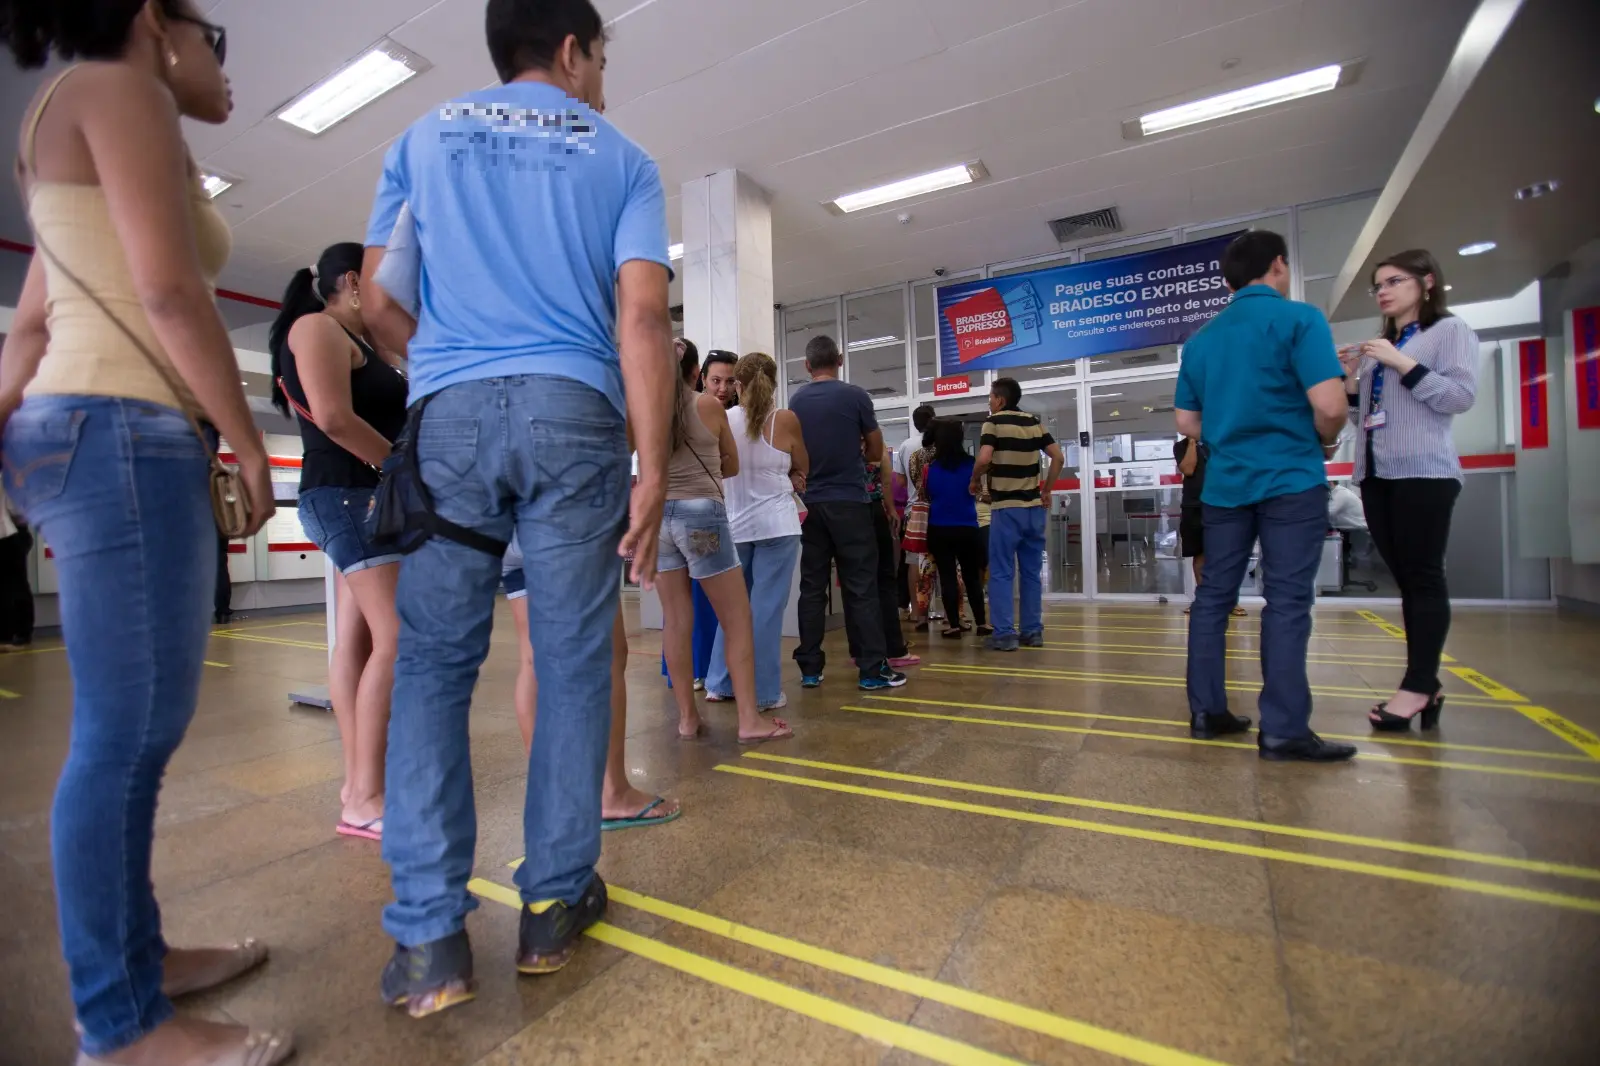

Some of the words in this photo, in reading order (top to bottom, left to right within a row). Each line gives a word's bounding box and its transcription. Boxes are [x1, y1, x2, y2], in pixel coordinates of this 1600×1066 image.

[1055, 280, 1102, 297] Pague
[1106, 273, 1143, 288] suas
[1148, 262, 1205, 281] contas
[1209, 259, 1221, 271] n
[1049, 289, 1137, 316] BRADESCO
[955, 309, 1007, 326] BRADESCO
[1052, 319, 1076, 330] Tem
[1079, 312, 1122, 325] sempre
[1125, 309, 1144, 319] um
[1147, 303, 1181, 318] perto
[1184, 299, 1200, 310] de
[956, 318, 1007, 335] EXPRESSO
[1067, 326, 1105, 338] Consulte
[1106, 325, 1117, 333] os
[1120, 318, 1166, 333] endereços
[1168, 316, 1180, 324] na
[974, 335, 1006, 346] Bradesco
[936, 380, 967, 392] Entrada
